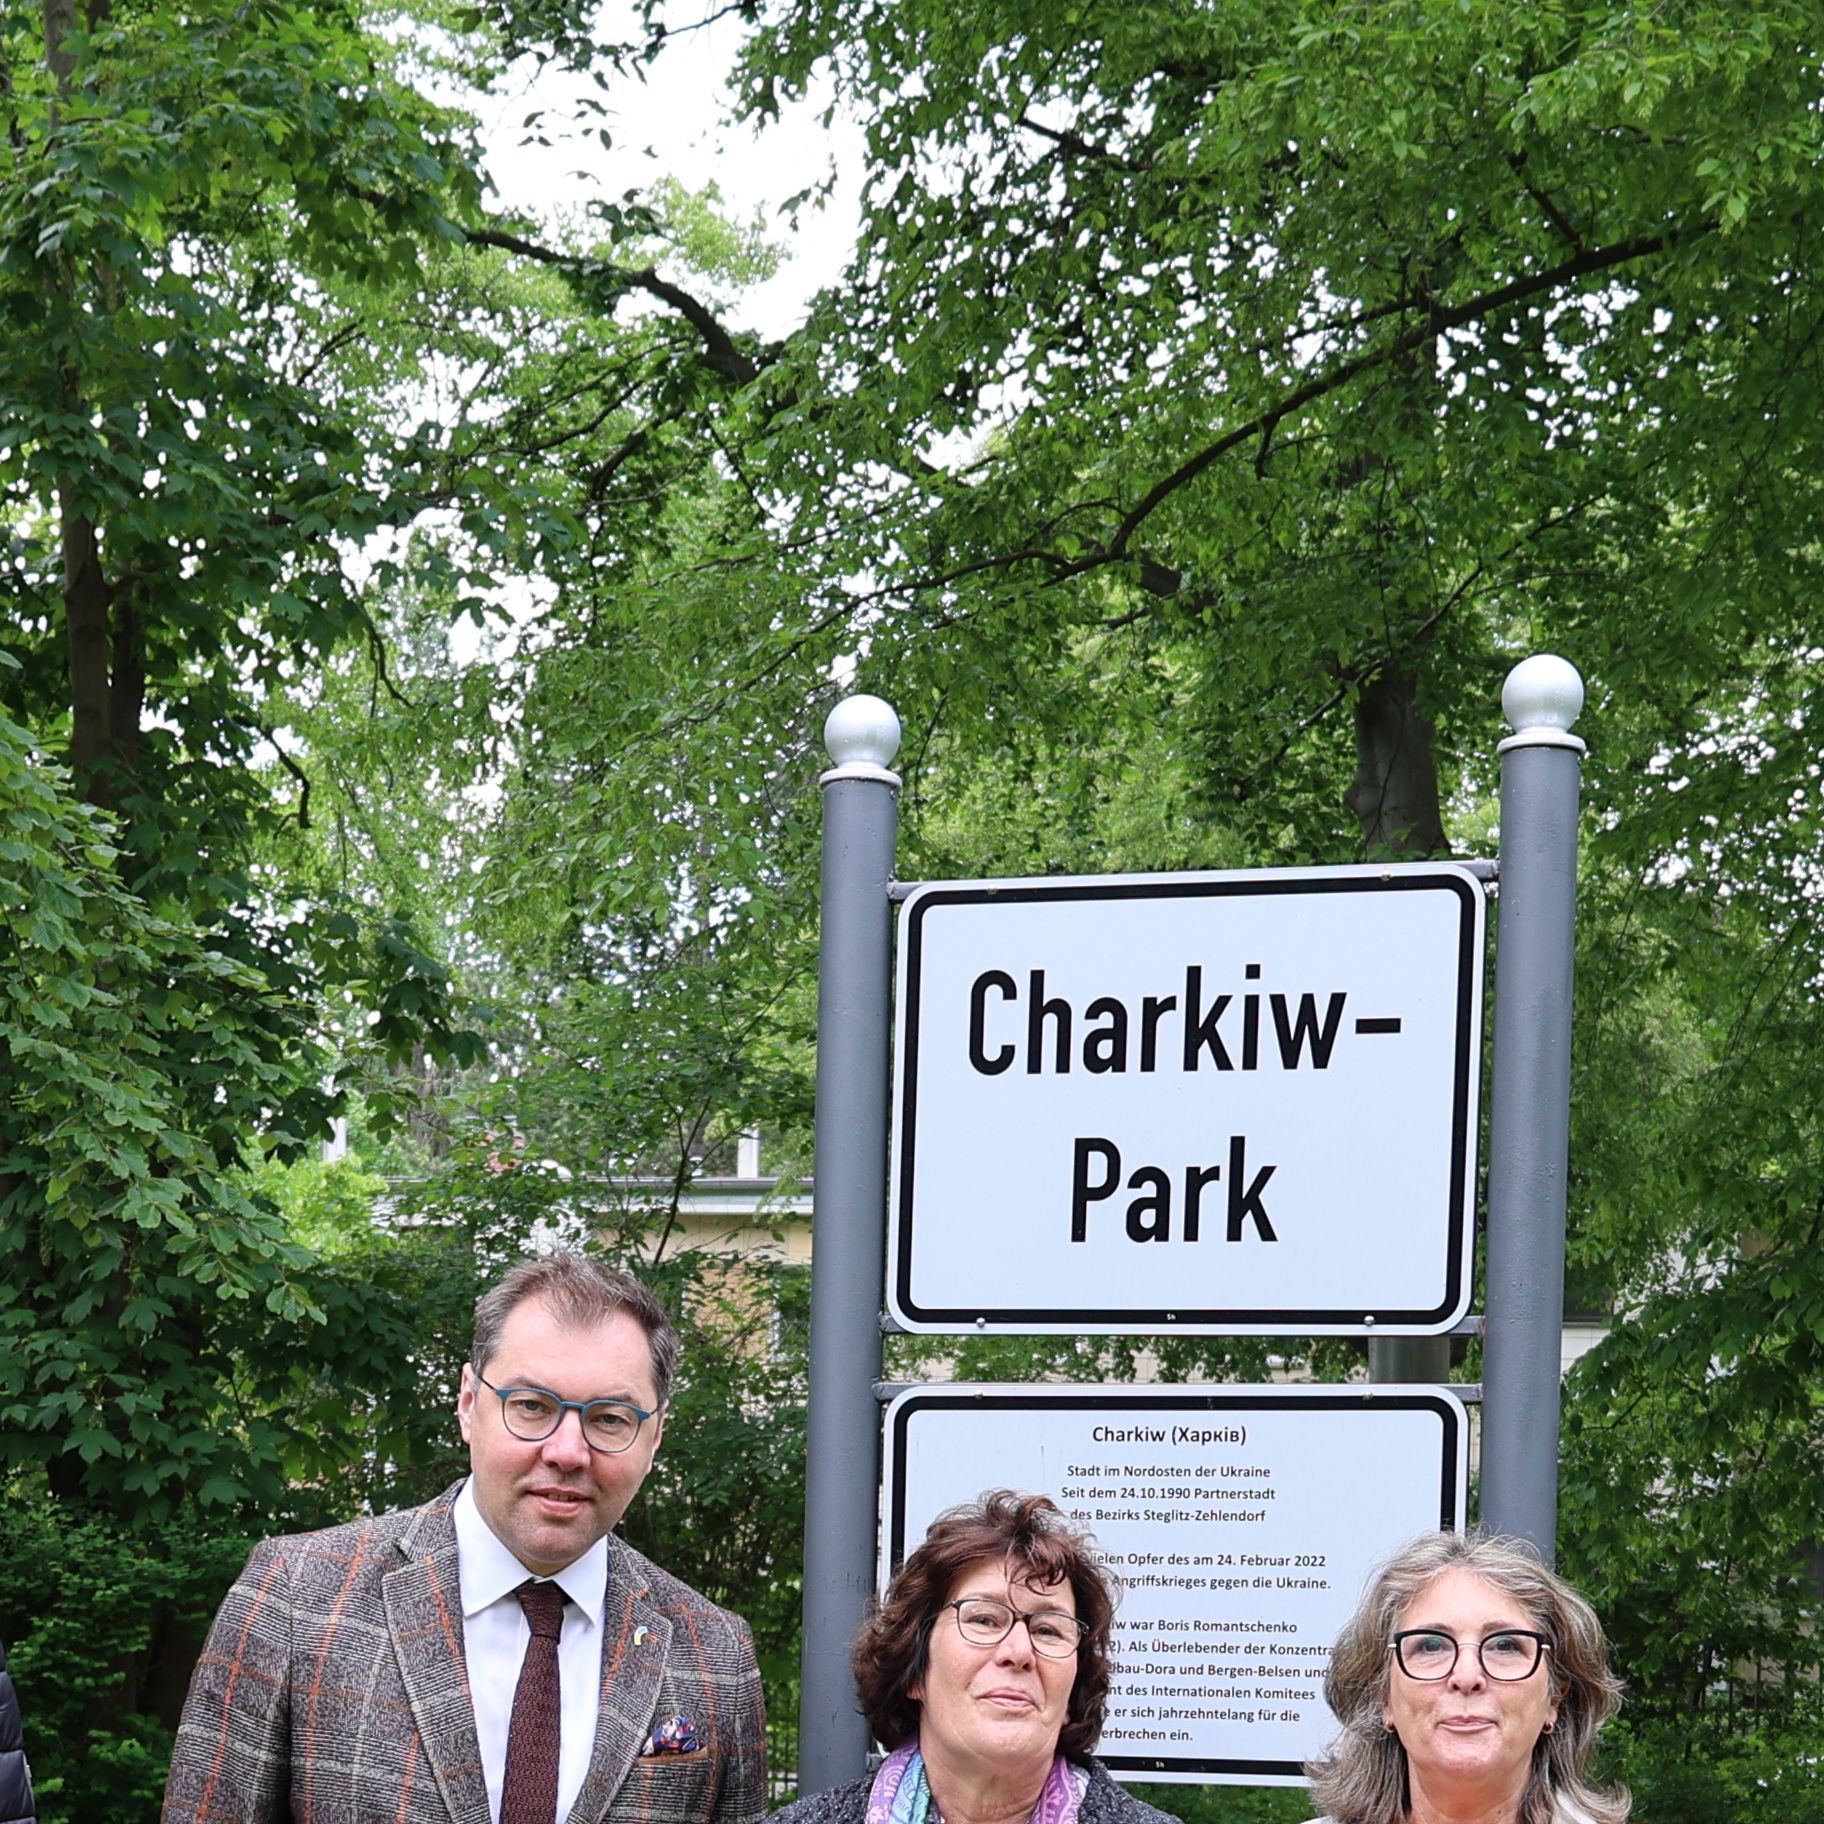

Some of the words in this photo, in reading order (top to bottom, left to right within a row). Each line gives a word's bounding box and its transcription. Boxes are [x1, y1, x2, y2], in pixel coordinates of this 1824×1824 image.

[969, 964, 1401, 1076] Charkiw-
[1071, 1136, 1278, 1243] Park
[1093, 1426, 1165, 1442] Charkiw
[1172, 1426, 1246, 1446] (Харків)
[1068, 1465, 1100, 1476] Stadt
[1105, 1465, 1119, 1477] im
[1124, 1466, 1191, 1476] Nordosten
[1195, 1466, 1216, 1477] der
[1221, 1466, 1270, 1477] Ukraine
[1062, 1487, 1084, 1498] Seit
[1089, 1487, 1116, 1498] dem
[1121, 1488, 1190, 1498] 24.10.1990
[1195, 1488, 1275, 1499] Partnerstadt
[1071, 1509, 1091, 1520] des
[1096, 1509, 1140, 1520] Bezirks
[1144, 1510, 1265, 1523] Steglitz-Zehlendorf
[1128, 1553, 1164, 1566] Opfer
[1168, 1554, 1189, 1565] des
[1194, 1557, 1213, 1565] am
[1218, 1555, 1236, 1566] 24.
[1241, 1555, 1290, 1566] Februar
[1295, 1556, 1325, 1566] 2022
[1112, 1575, 1206, 1590] Angriffskrieges
[1210, 1579, 1248, 1590] gegen
[1253, 1577, 1272, 1588] die
[1277, 1577, 1330, 1589] Ukraine.
[1130, 1622, 1154, 1630] war
[1158, 1620, 1189, 1630] Boris
[1194, 1620, 1297, 1632] Romantschenko
[1129, 1641, 1147, 1652] Als
[1152, 1639, 1240, 1654] Überlebender
[1244, 1643, 1265, 1654] der
[1180, 1664, 1203, 1675] und
[1208, 1665, 1300, 1678] Bergen-Belsen
[1126, 1684, 1147, 1695] des
[1152, 1686, 1250, 1698] Internationalen
[1255, 1688, 1315, 1699] Komitees
[1115, 1709, 1127, 1717] er
[1131, 1706, 1154, 1717] sich
[1158, 1707, 1254, 1723] jahrzehntelang
[1258, 1709, 1276, 1720] für
[1280, 1710, 1300, 1721] die
[1101, 1727, 1166, 1740] erbrechen
[1170, 1730, 1192, 1740] ein.
